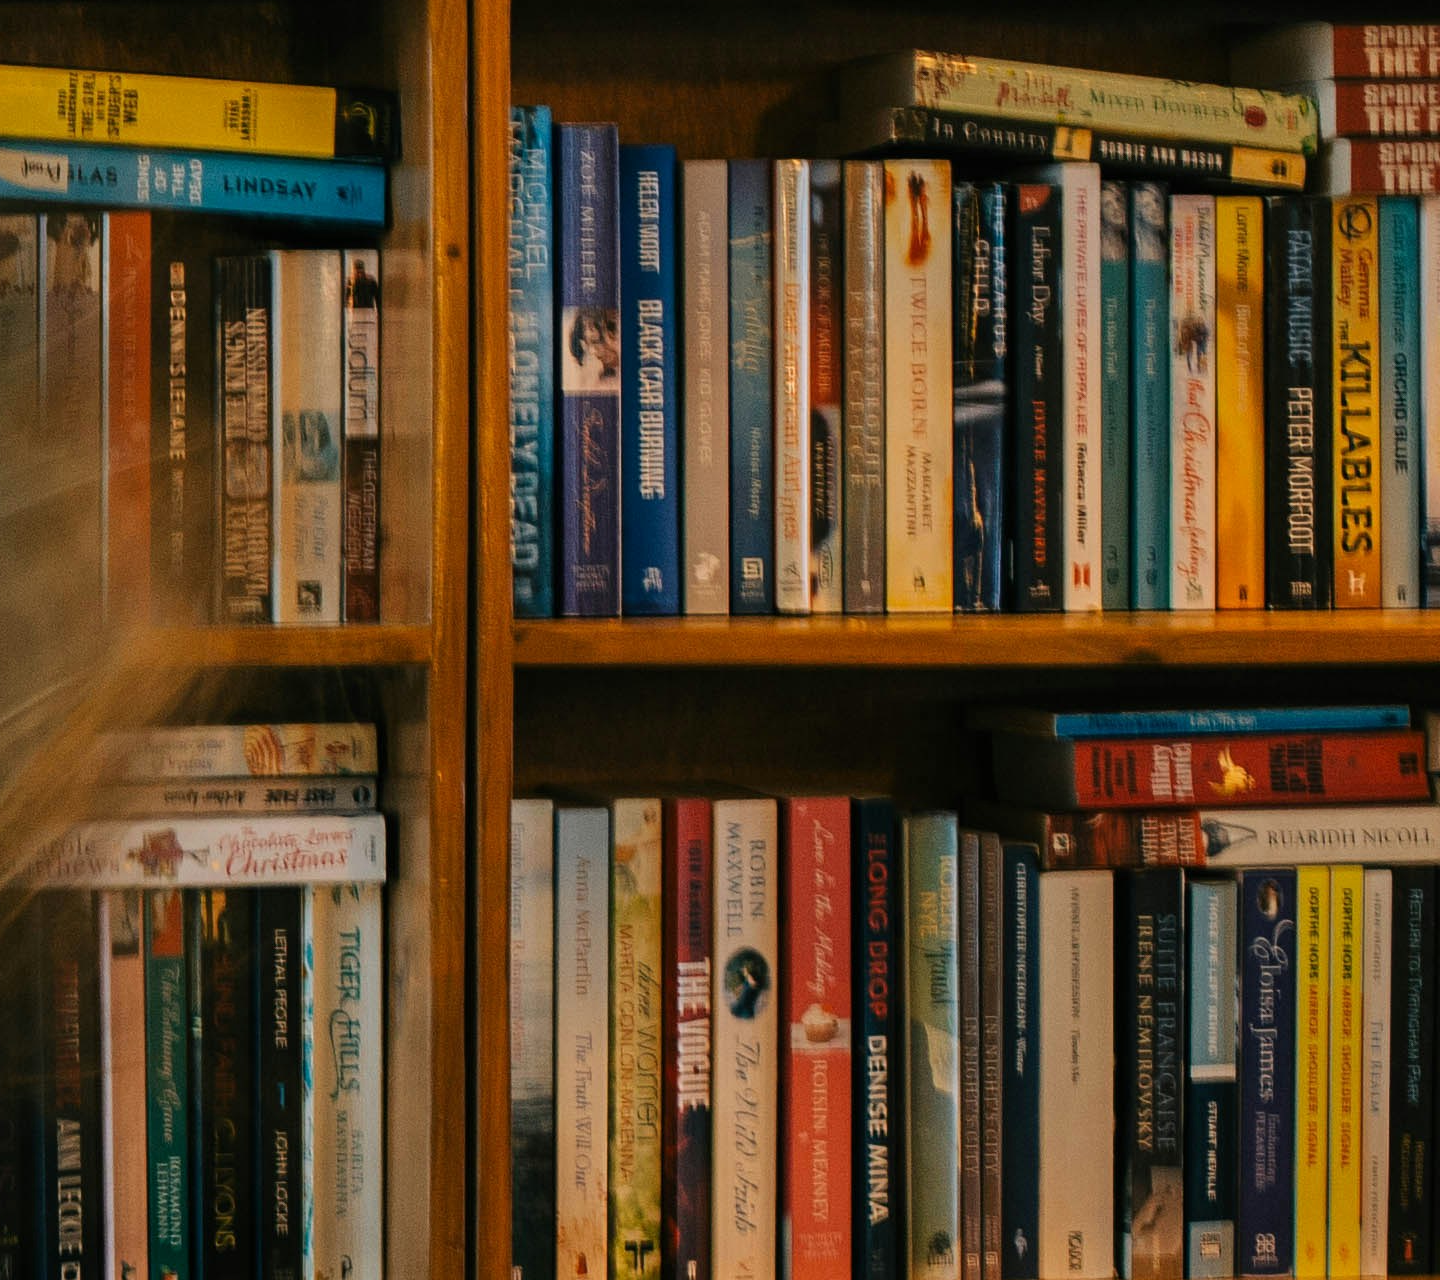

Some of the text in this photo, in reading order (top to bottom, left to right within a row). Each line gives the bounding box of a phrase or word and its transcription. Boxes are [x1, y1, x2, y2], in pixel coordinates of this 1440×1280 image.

[1286, 387, 1315, 554] PETER MORFOOT
[1339, 343, 1374, 554] KILLABLES
[865, 848, 893, 1016] LONG DROP
[675, 959, 711, 1112] THE VOGUE
[863, 1036, 893, 1223] DENISE MINA
